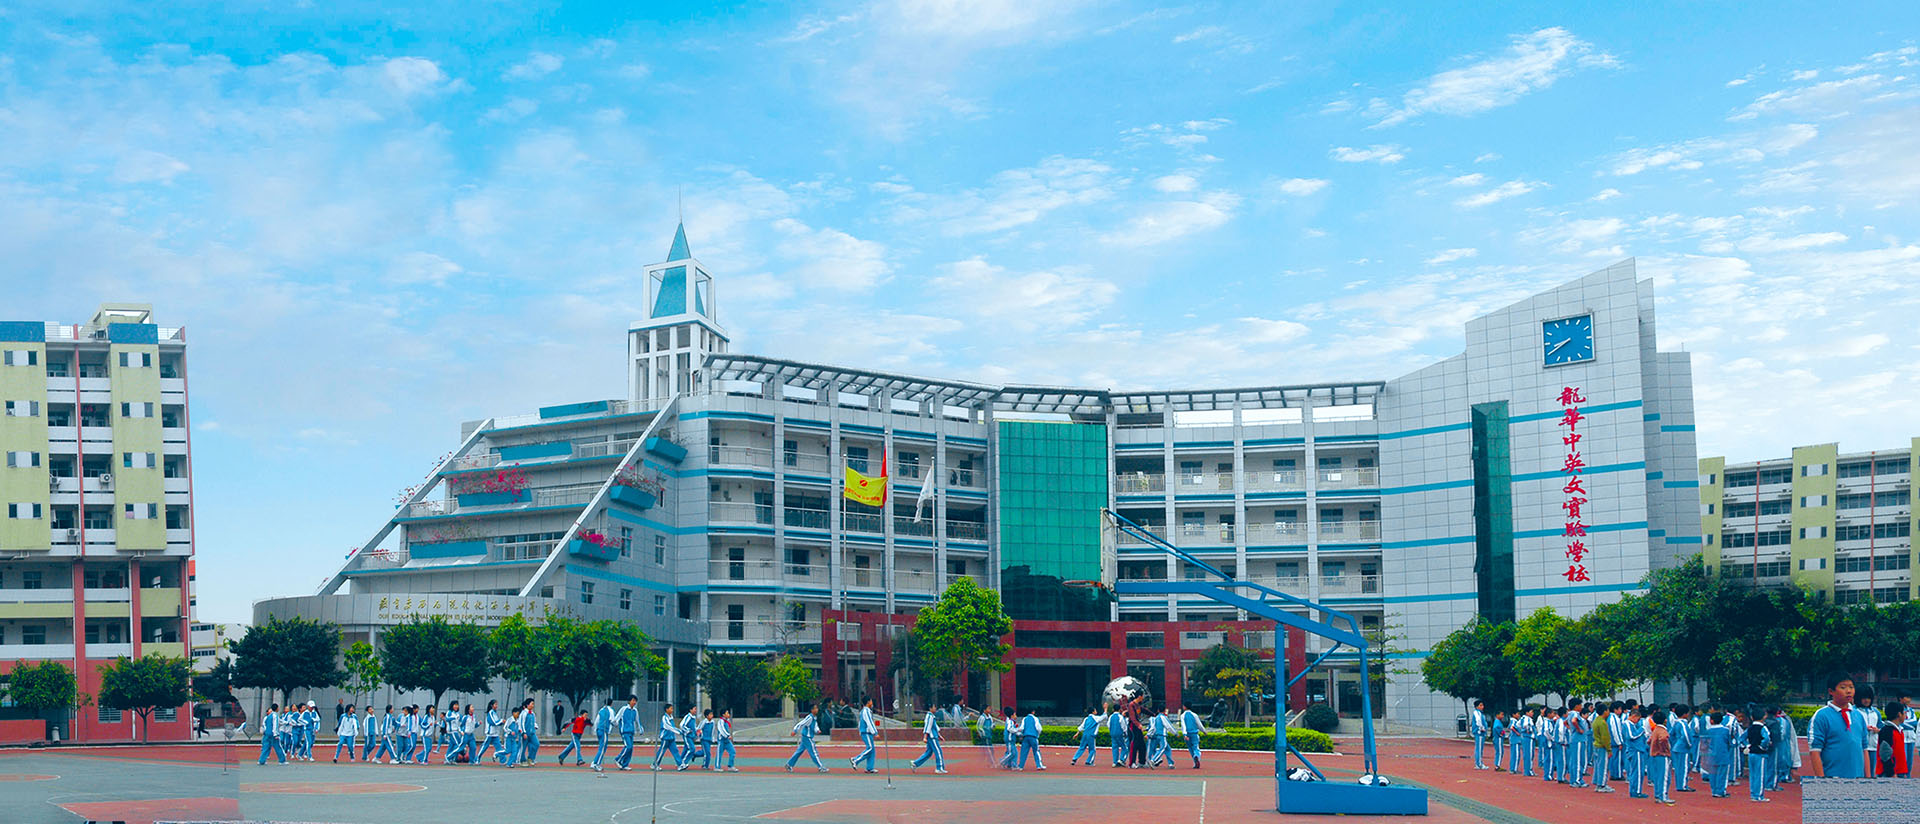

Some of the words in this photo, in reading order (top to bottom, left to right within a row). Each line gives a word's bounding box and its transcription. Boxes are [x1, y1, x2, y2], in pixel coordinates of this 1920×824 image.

[1556, 386, 1591, 582] 龍華中英文實驗學校
